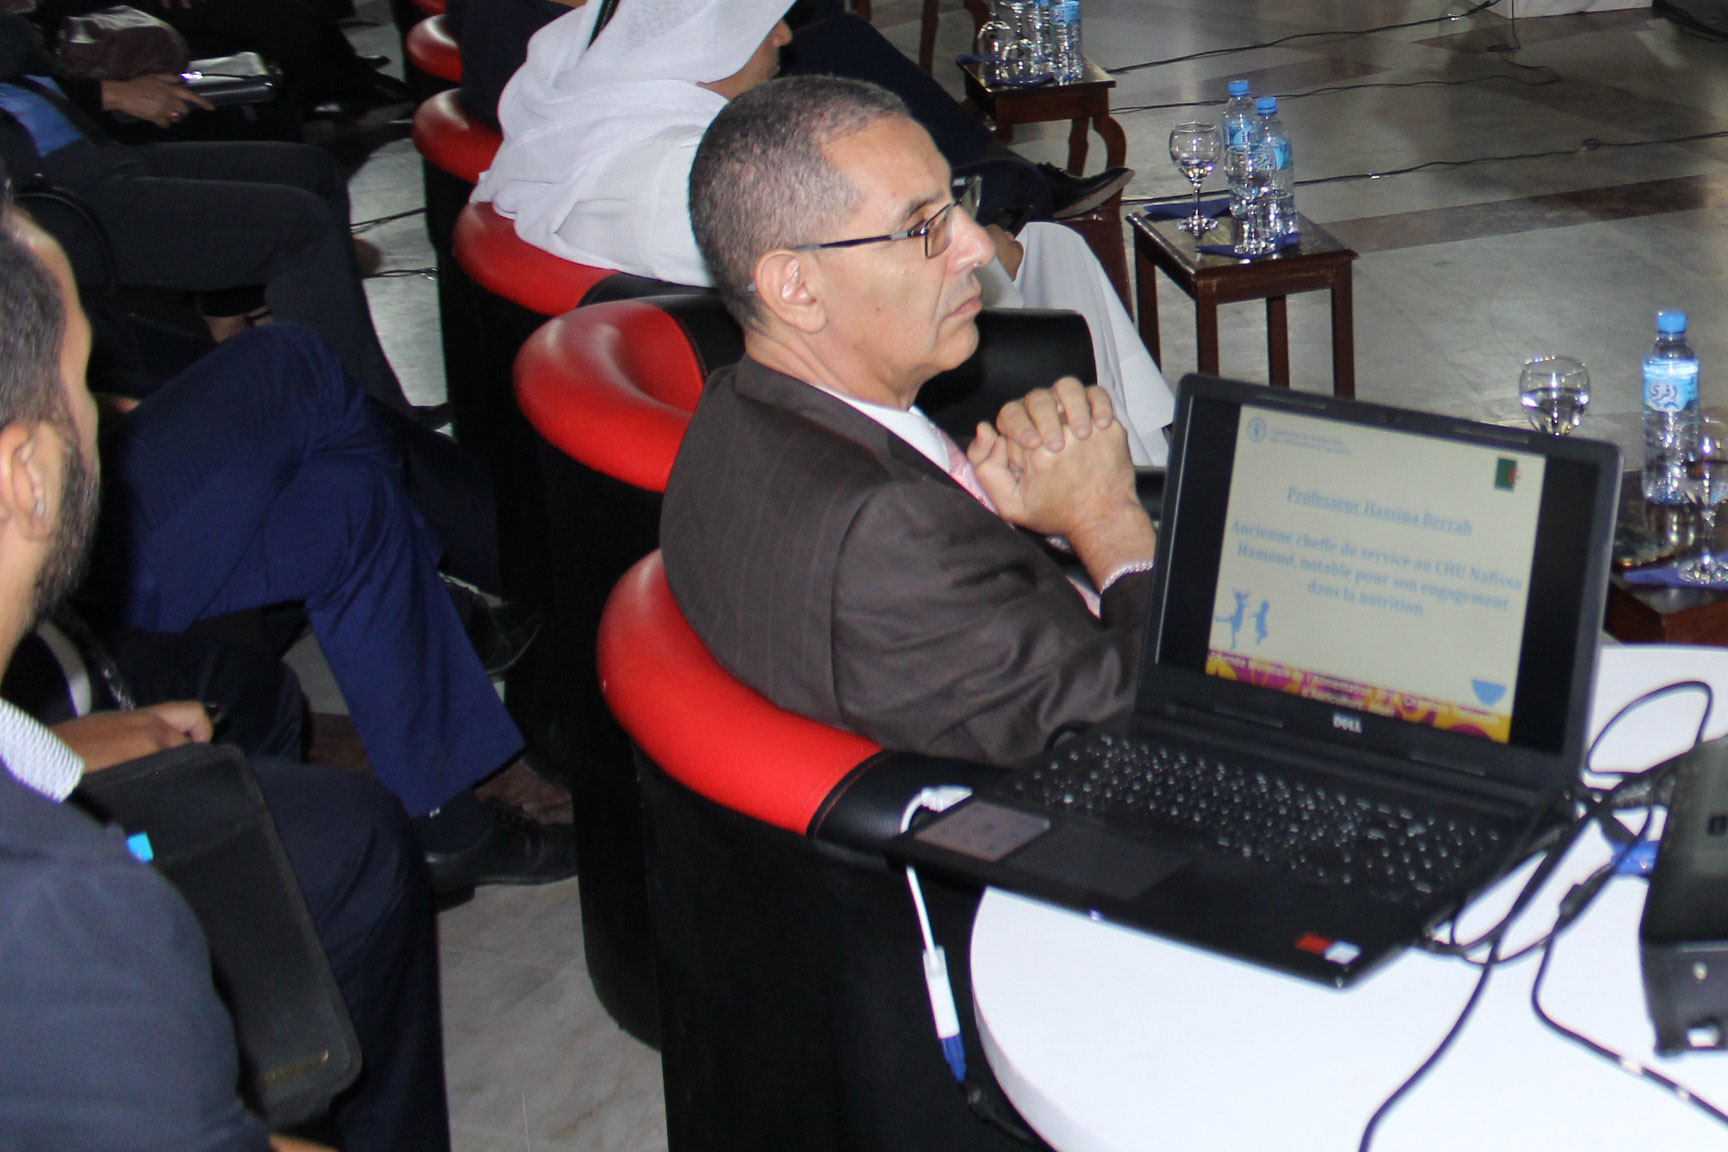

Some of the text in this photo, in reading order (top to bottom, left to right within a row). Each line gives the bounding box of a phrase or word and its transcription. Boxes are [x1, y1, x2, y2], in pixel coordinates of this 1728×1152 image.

[1287, 486, 1360, 517] Professeur
[1231, 520, 1294, 545] Ancienne
[1340, 542, 1357, 557] de
[1361, 548, 1411, 567] service
[1414, 558, 1432, 573] au
[1300, 556, 1352, 579] notable
[1355, 569, 1388, 590] pour
[1392, 577, 1418, 593] son
[1421, 582, 1509, 612] engagement
[1306, 579, 1340, 599] dans
[1343, 586, 1356, 602] la
[1332, 712, 1363, 734] DELL
